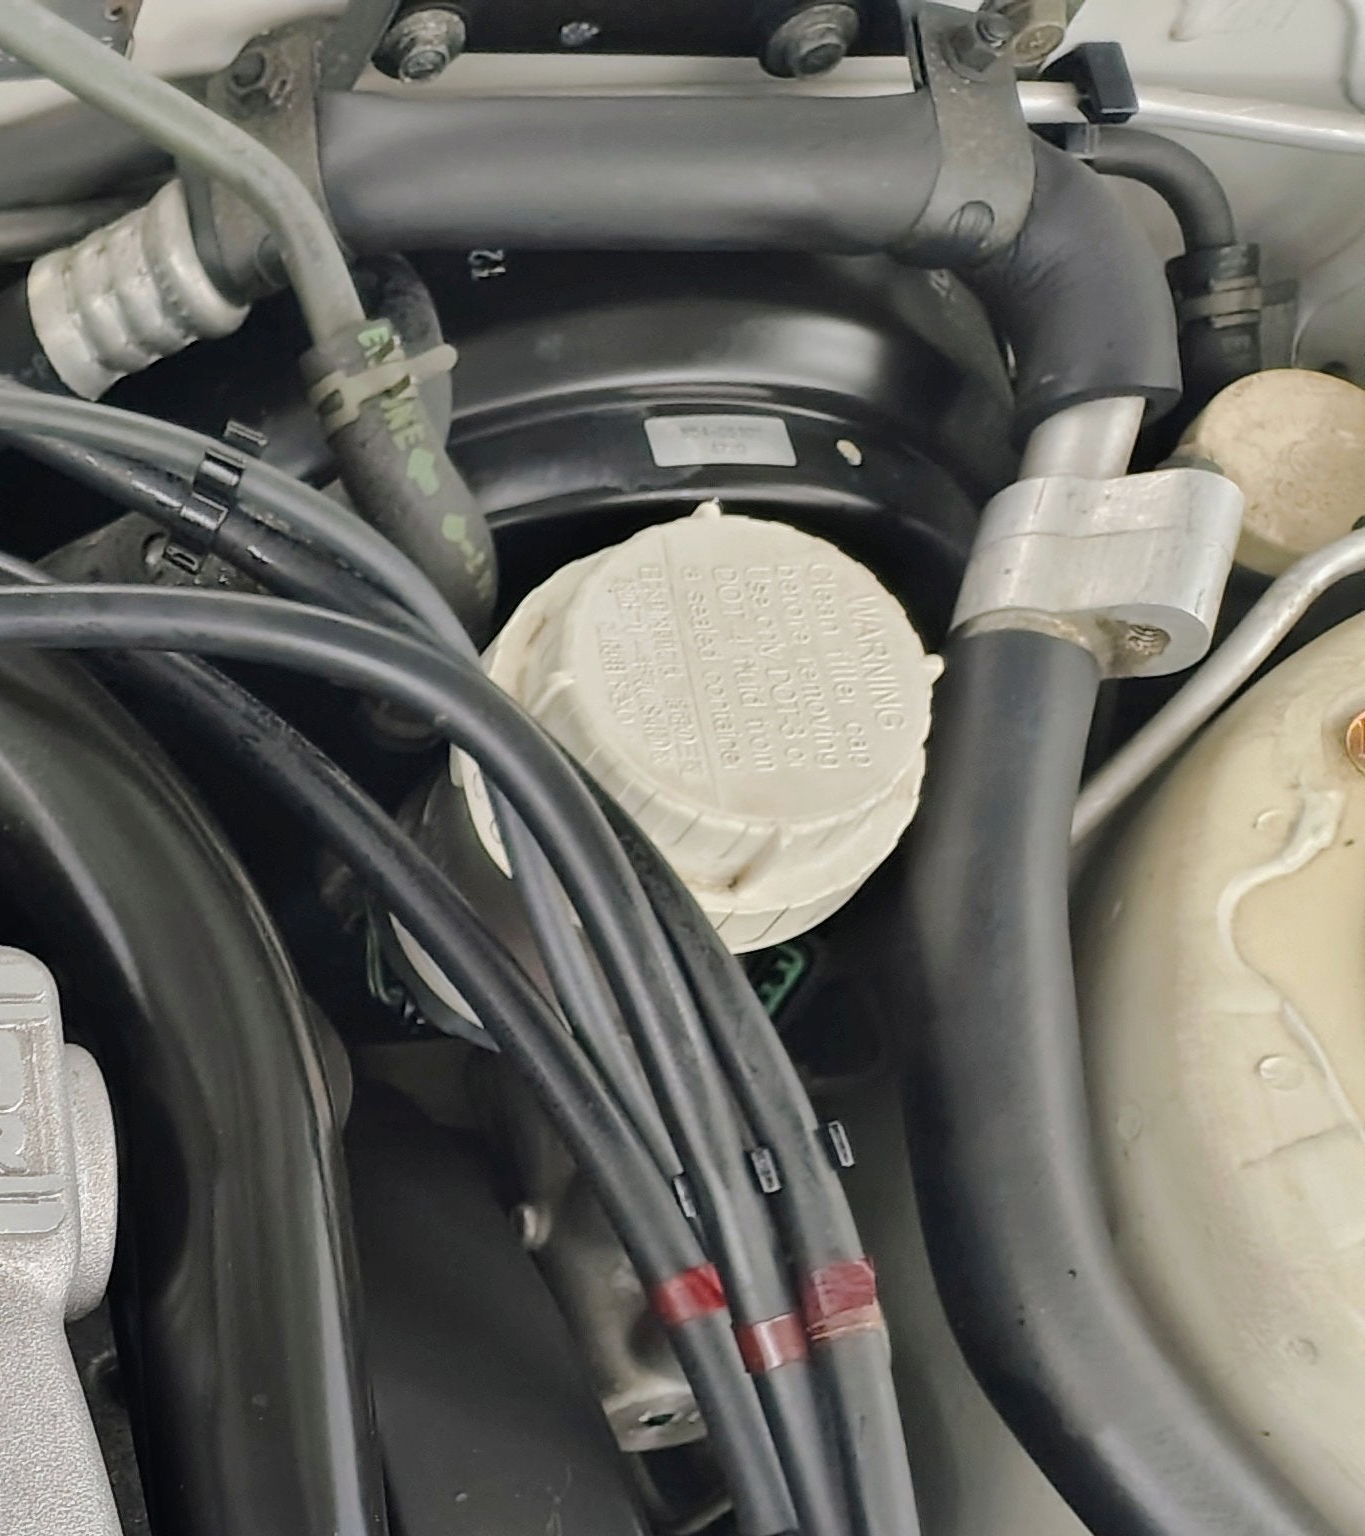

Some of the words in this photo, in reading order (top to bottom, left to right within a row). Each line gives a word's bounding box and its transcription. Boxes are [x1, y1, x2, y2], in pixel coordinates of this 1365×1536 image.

[686, 591, 720, 663] sealed
[809, 562, 842, 636] Clean
[774, 564, 813, 646] before
[795, 657, 842, 770] removing
[827, 648, 859, 704] filler
[844, 594, 906, 732] WARNING
[744, 717, 778, 774] from
[842, 720, 873, 769] cap
